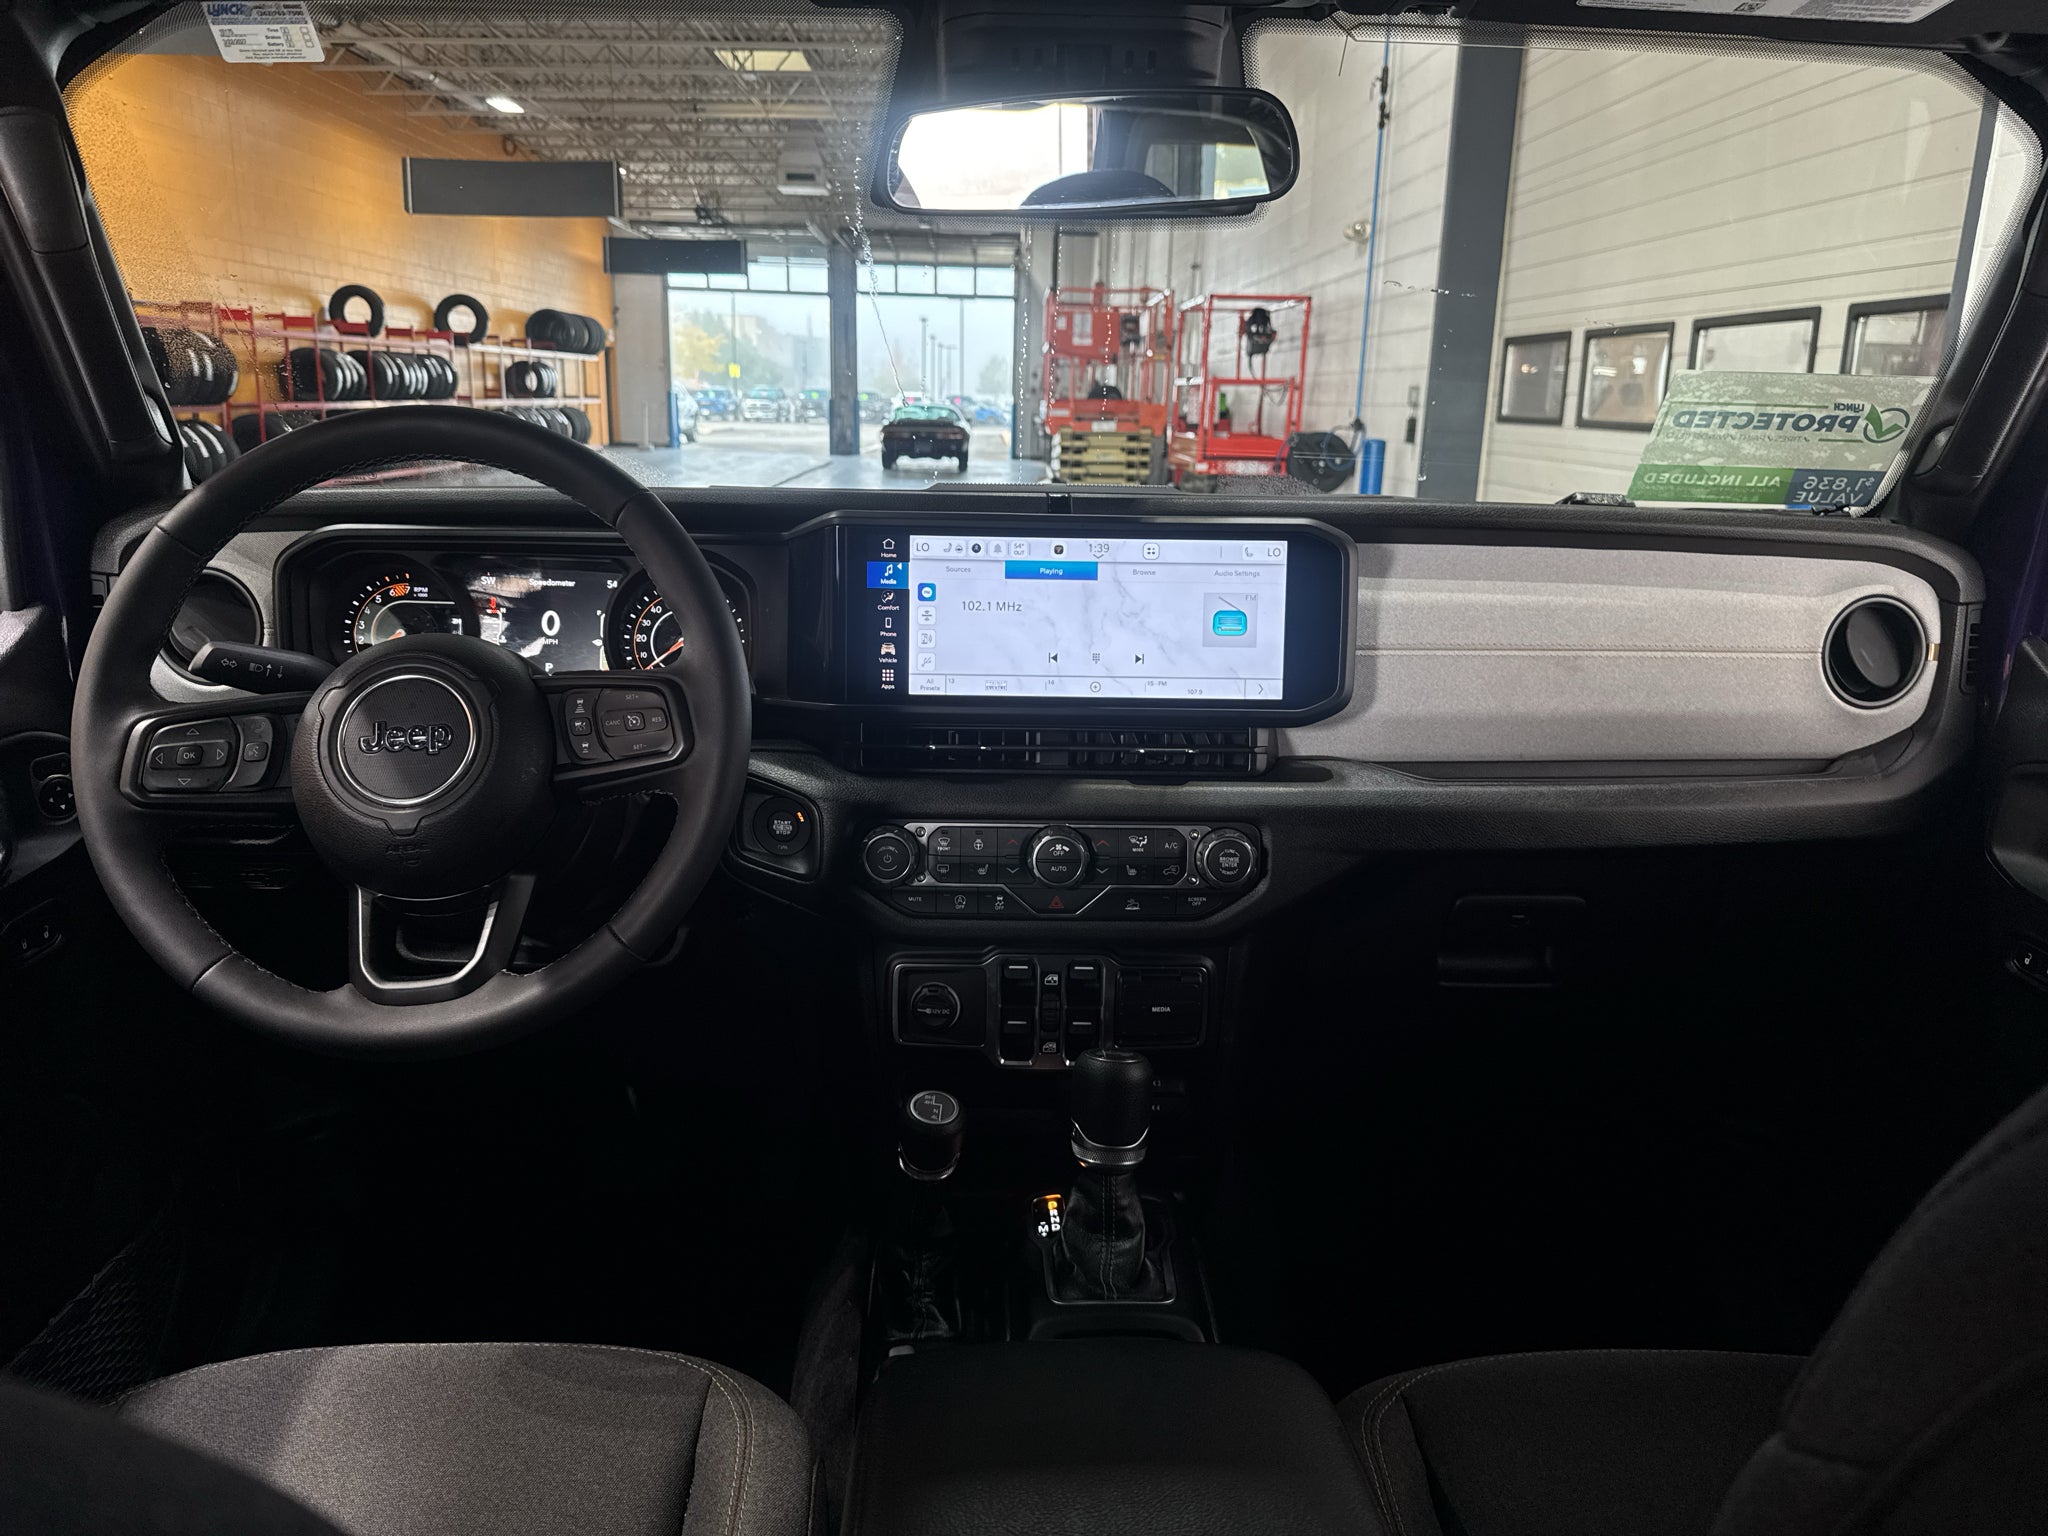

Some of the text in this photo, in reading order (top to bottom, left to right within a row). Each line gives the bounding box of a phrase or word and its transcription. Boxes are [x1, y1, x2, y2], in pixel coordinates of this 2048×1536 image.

[916, 542, 930, 552] LO
[1089, 544, 1110, 553] 1:39
[1268, 548, 1281, 557] LO
[1040, 568, 1064, 576] Playing
[1234, 570, 1260, 578] Settings
[481, 576, 496, 584] SW
[529, 579, 576, 587] Speedometer
[405, 586, 411, 594] 7
[375, 595, 382, 603] 5
[364, 606, 371, 614] 4
[651, 605, 662, 613] 40
[961, 601, 1022, 612] 102.1 MHz
[358, 621, 365, 629] 3
[541, 610, 560, 636] 0
[642, 619, 651, 627] 30
[358, 636, 365, 644] 2
[636, 634, 647, 642] 20
[545, 663, 553, 672] P
[359, 720, 453, 755] Jeep
